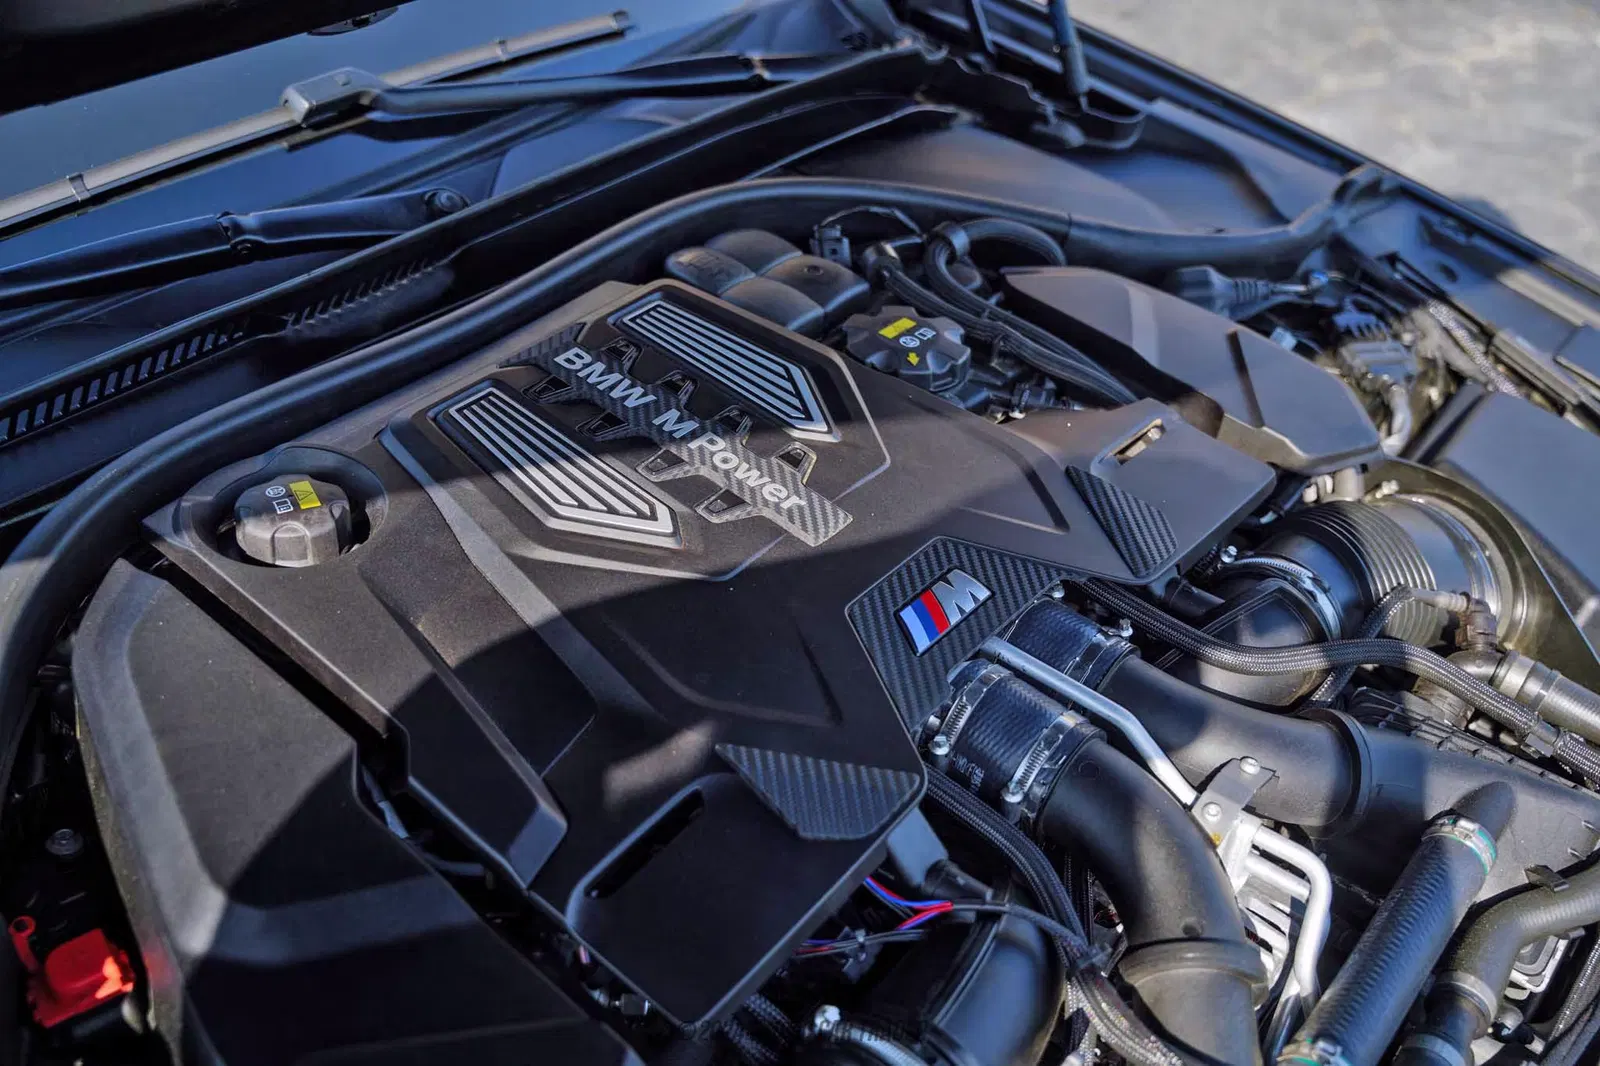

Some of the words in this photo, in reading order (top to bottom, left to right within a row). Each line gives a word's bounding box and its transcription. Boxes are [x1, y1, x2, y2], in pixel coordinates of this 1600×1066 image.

[553, 346, 656, 408] BMW
[652, 409, 699, 439] M
[687, 431, 806, 510] Power
[931, 568, 992, 626] M
